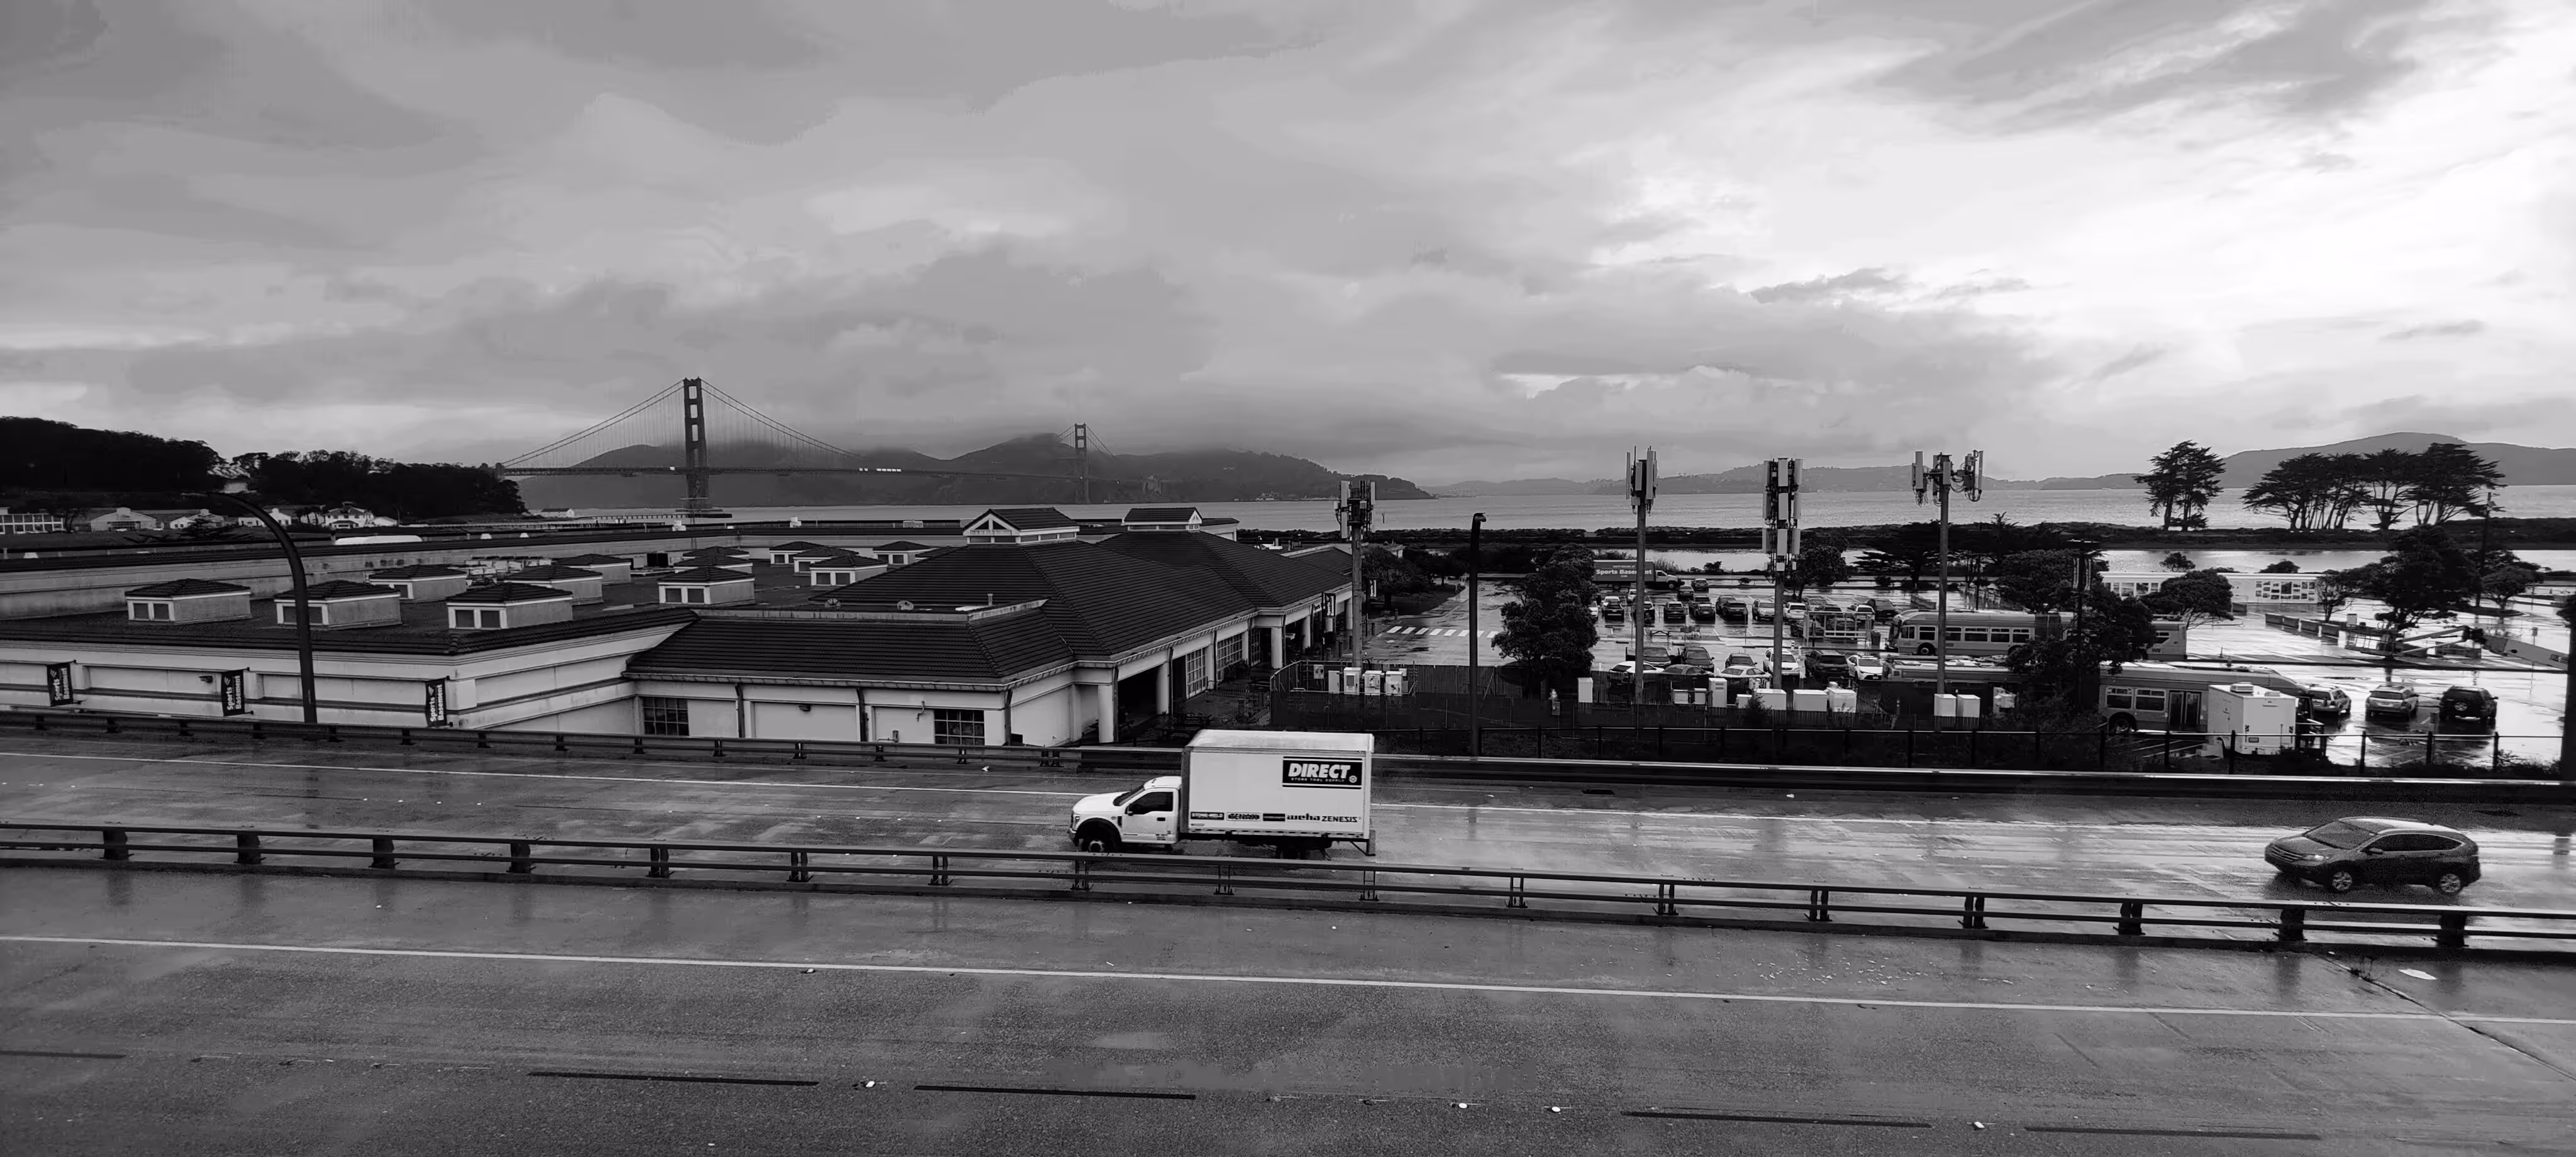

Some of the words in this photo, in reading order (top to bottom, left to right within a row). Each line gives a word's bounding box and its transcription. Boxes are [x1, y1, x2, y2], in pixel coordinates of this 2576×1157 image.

[53, 678, 62, 700] Sports
[226, 687, 235, 711] Sports
[429, 697, 438, 722] Sports
[1288, 763, 1351, 778] DIRECT
